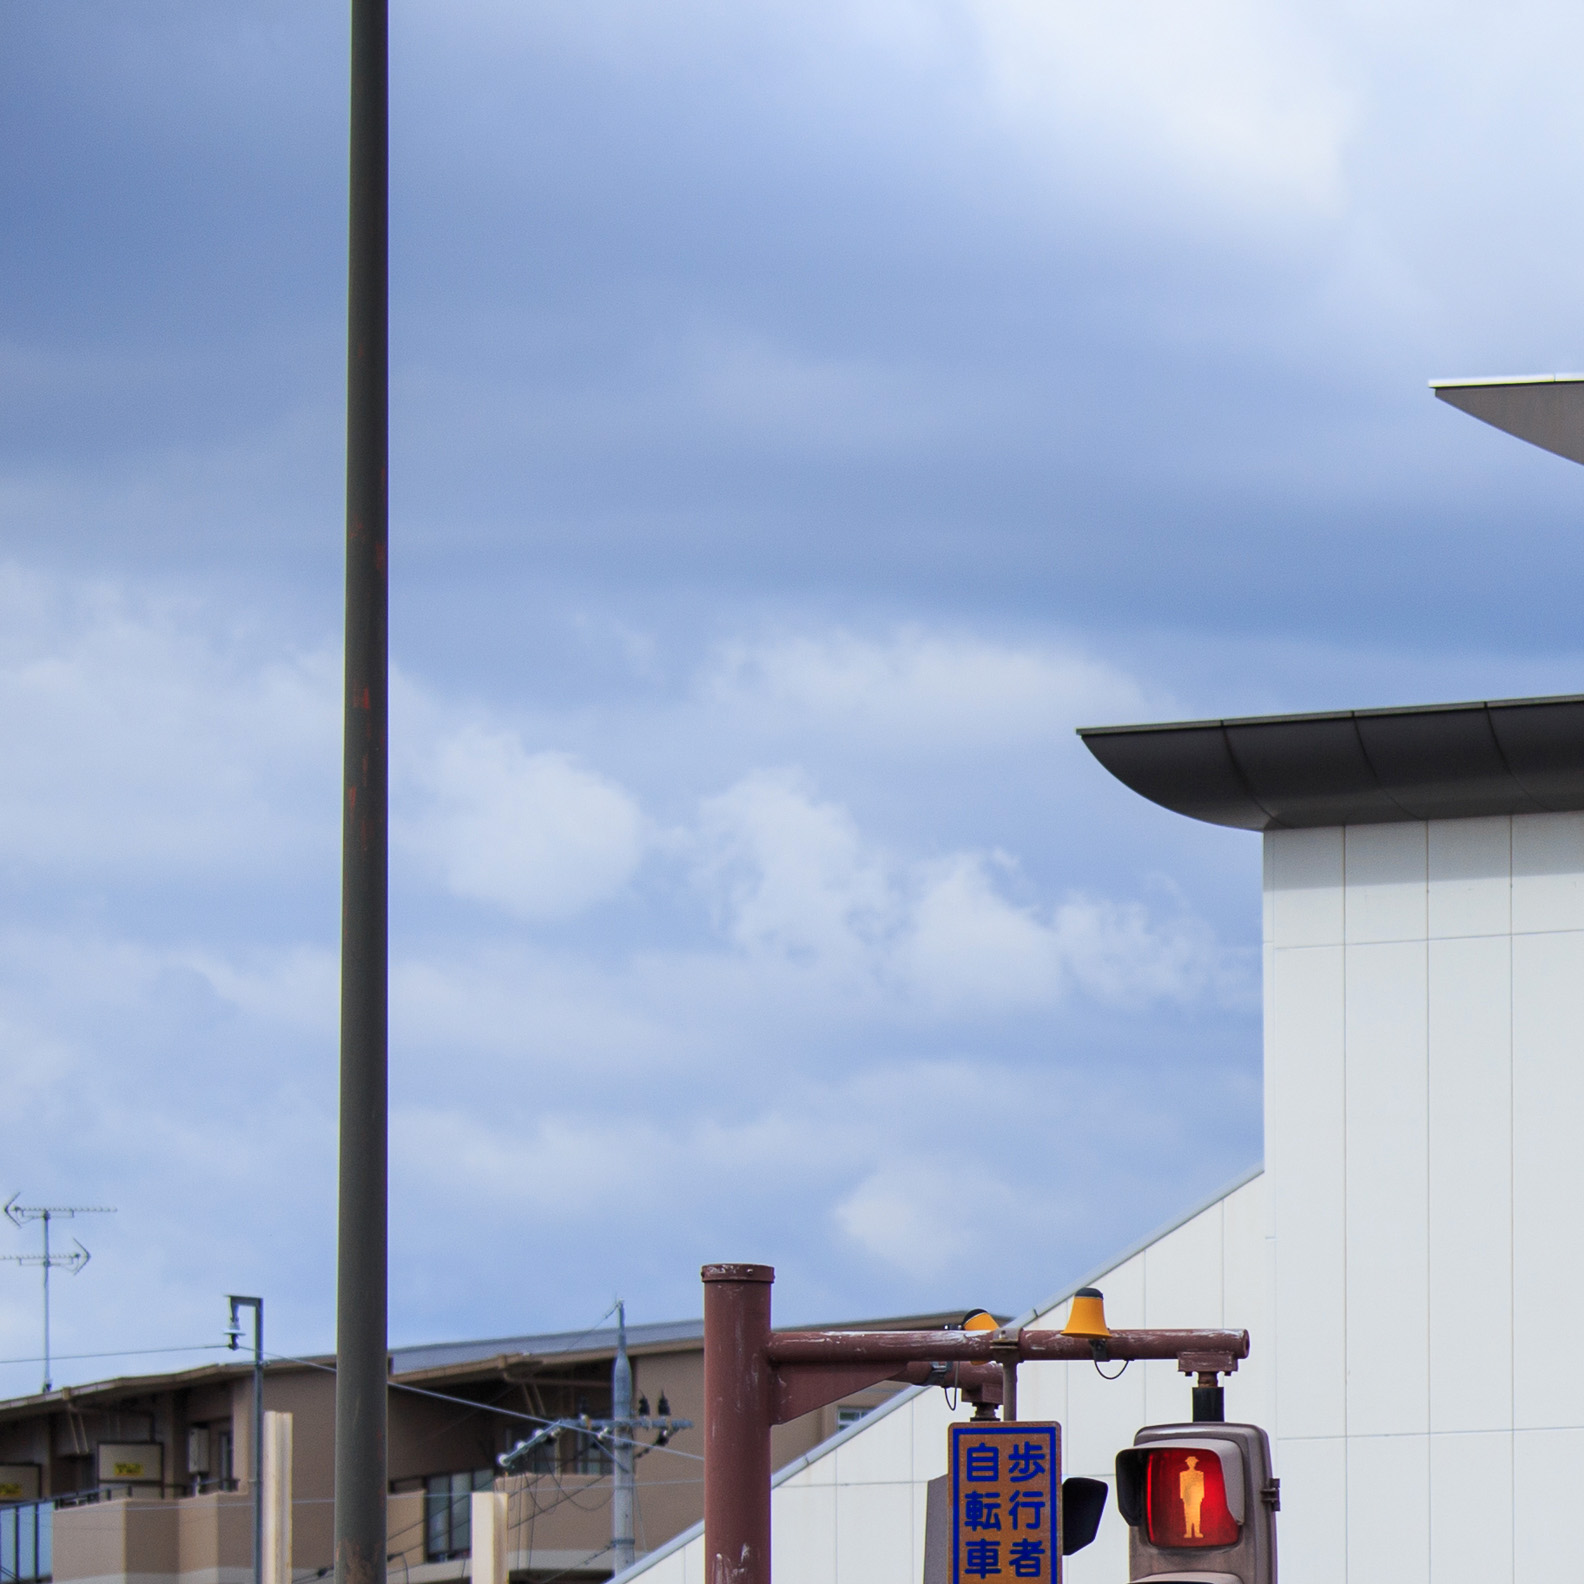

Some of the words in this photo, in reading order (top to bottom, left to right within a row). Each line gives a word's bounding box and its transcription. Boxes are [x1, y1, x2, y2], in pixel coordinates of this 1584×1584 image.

[964, 1442, 1002, 1579] 自転車
[1008, 1441, 1046, 1578] 歩行者
